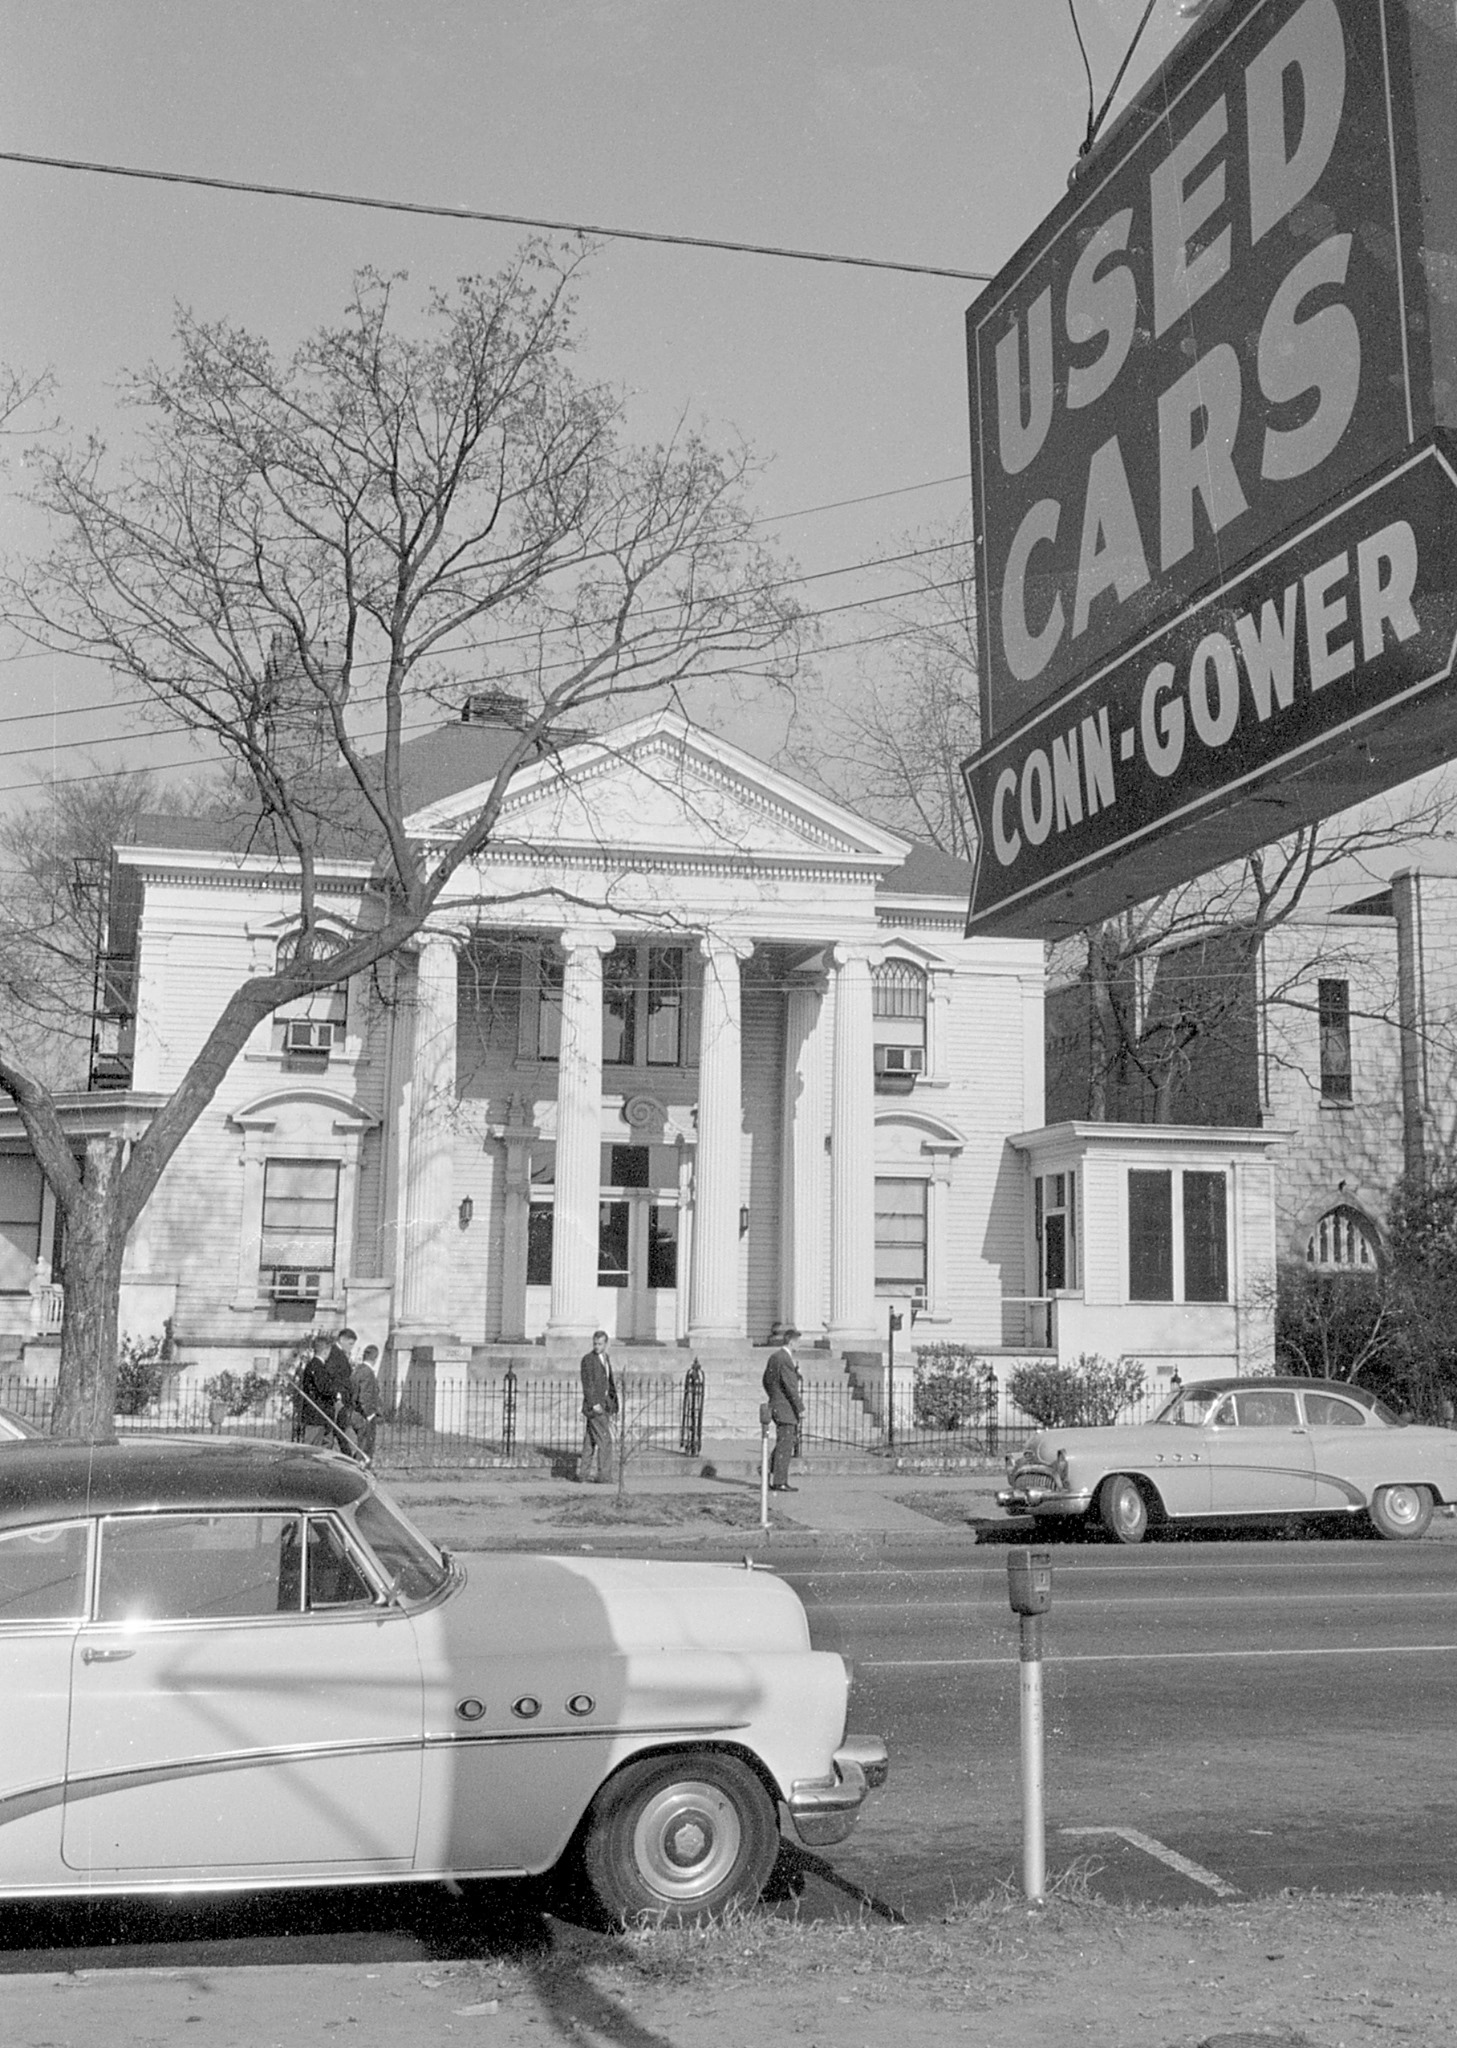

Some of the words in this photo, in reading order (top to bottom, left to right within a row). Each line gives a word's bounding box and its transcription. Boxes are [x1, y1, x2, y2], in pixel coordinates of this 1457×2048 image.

[996, 0, 1346, 474] USED
[1002, 233, 1361, 680] CARS
[992, 520, 1421, 866] CONN-GOWER
